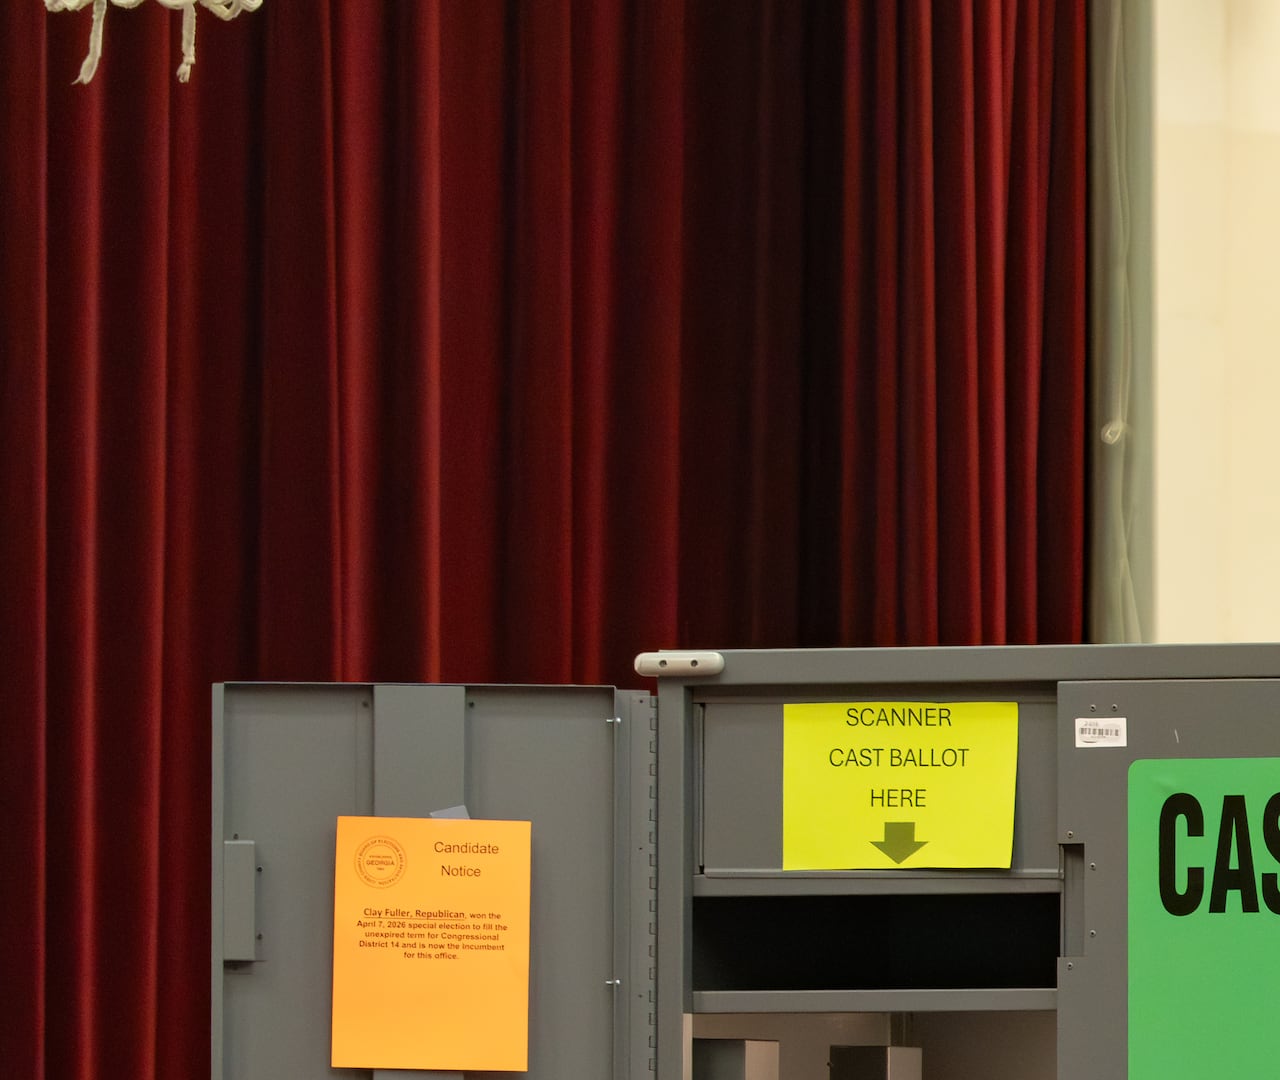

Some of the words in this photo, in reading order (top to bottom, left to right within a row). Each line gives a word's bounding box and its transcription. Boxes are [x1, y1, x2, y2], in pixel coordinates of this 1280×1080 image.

[846, 707, 952, 727] SCANNER
[829, 748, 884, 767] CAST
[890, 748, 969, 767] BALLOT
[870, 789, 927, 807] HERE
[434, 841, 499, 854] Candidate
[441, 864, 481, 877] Notice
[363, 907, 382, 917] Clay
[385, 908, 413, 918] Fuller,
[356, 920, 376, 929] April
[387, 921, 406, 929] 2026
[408, 922, 437, 931] special
[438, 922, 471, 930] election
[482, 923, 493, 931] fill
[365, 931, 405, 940] unexpired
[441, 932, 499, 941] Congressional
[359, 940, 388, 948] District
[401, 941, 417, 949] and
[434, 952, 459, 960] office.
